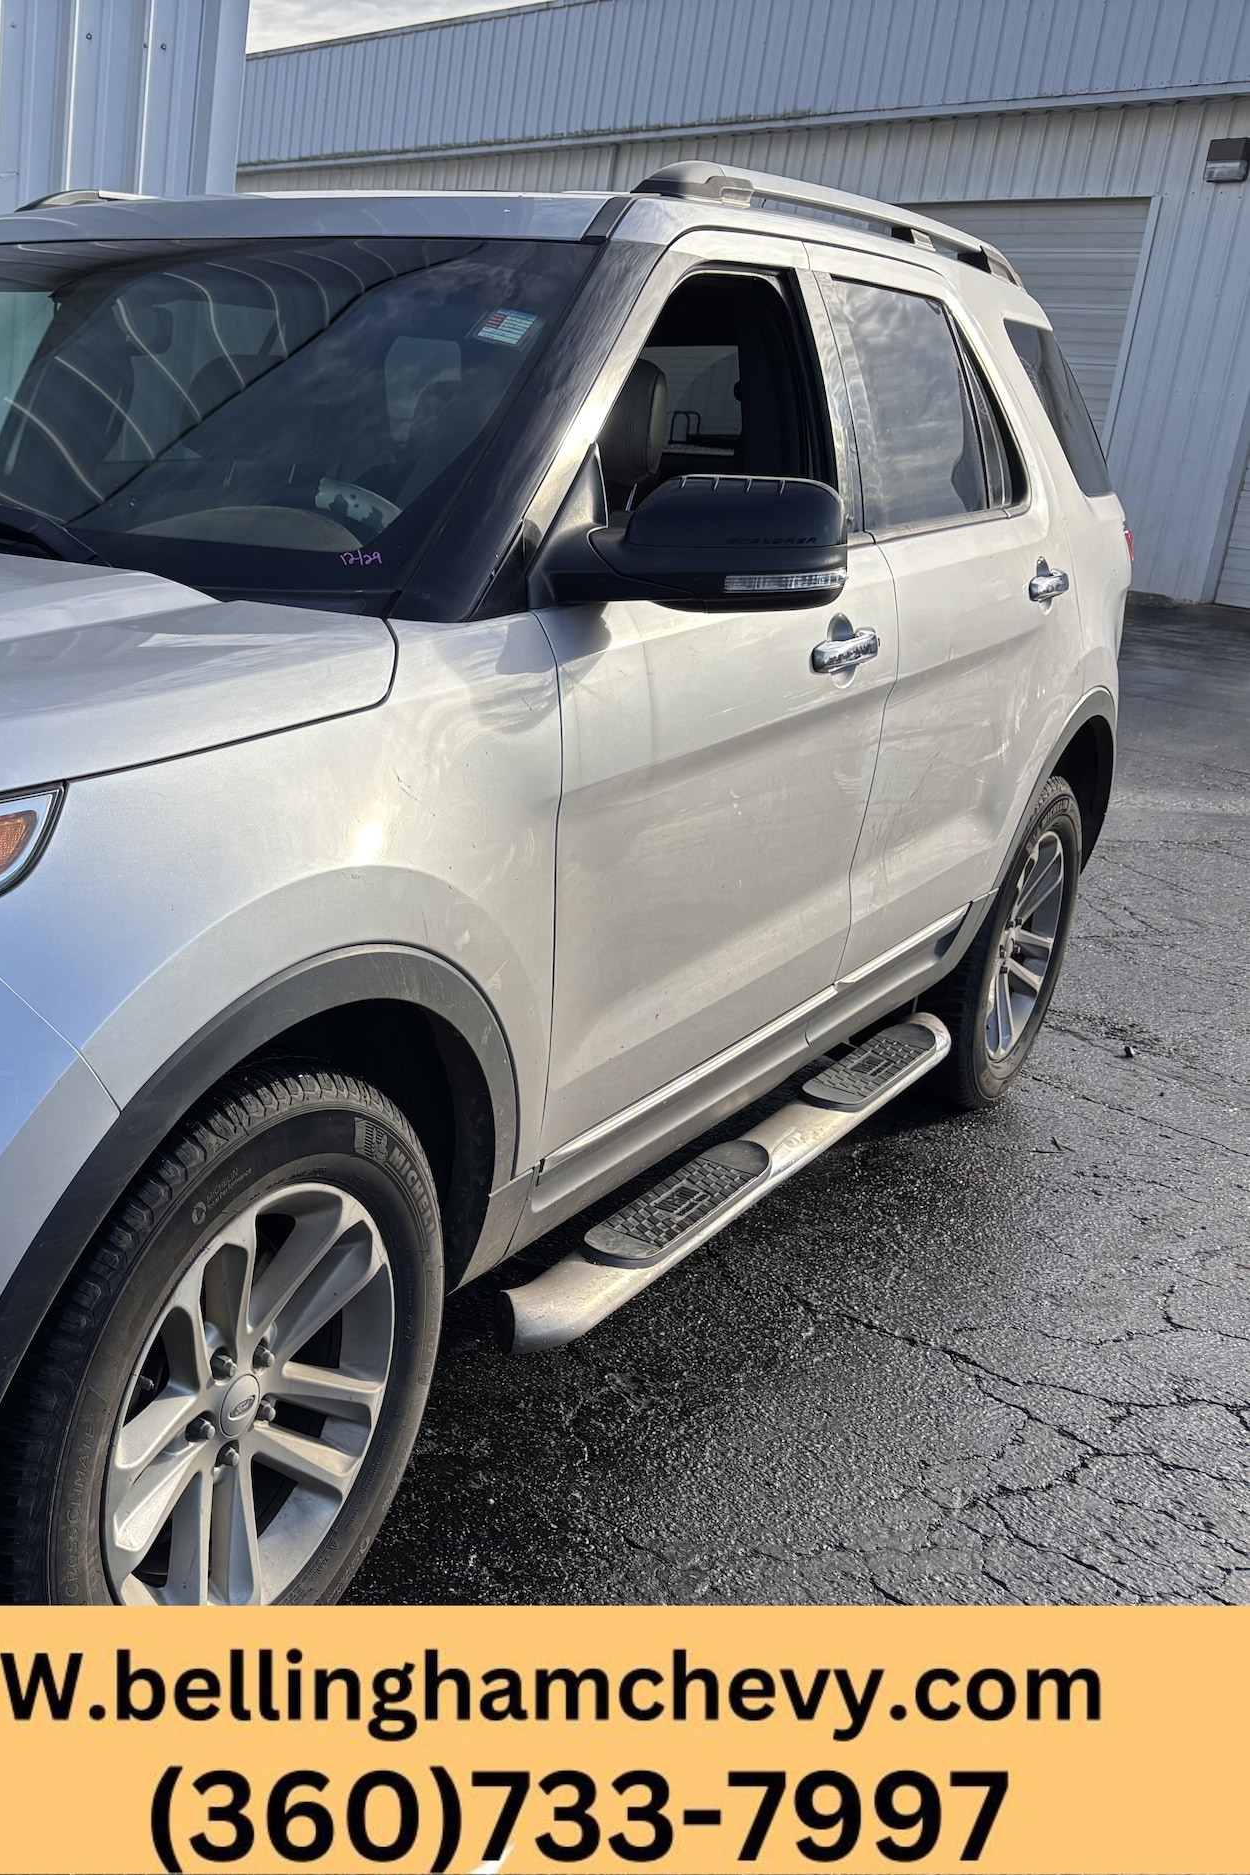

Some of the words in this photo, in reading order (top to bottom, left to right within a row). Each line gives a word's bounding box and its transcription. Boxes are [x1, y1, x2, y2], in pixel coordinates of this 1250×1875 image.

[726, 537, 817, 545] EXPLORER
[340, 549, 382, 566] 12/29
[388, 1146, 437, 1246] MICHELI
